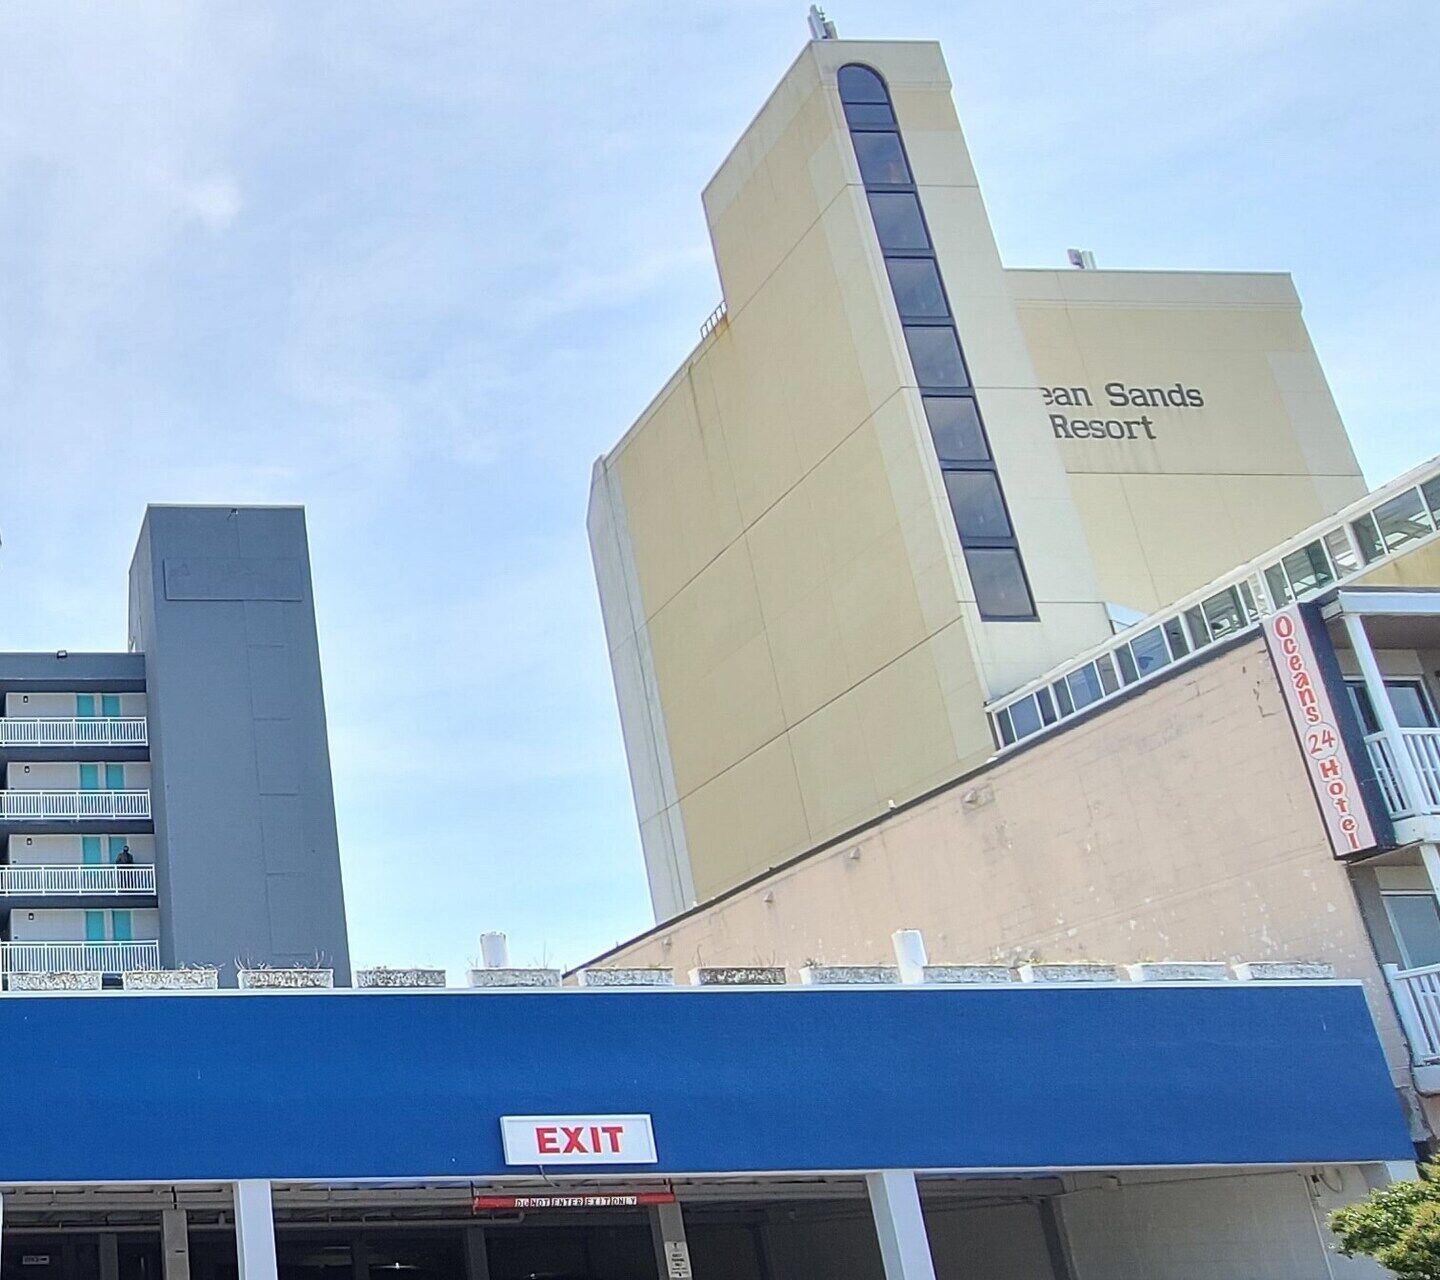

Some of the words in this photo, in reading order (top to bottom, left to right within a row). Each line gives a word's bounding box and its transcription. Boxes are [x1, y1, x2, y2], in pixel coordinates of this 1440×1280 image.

[1040, 387, 1093, 406] ean
[1104, 382, 1205, 407] Sands
[1048, 414, 1157, 440] Resort
[1274, 616, 1321, 723] Oceans
[1308, 729, 1336, 754] 24
[1319, 759, 1360, 850] Hotel
[535, 1126, 624, 1154] EXIT
[530, 1198, 550, 1207] NOT
[552, 1197, 583, 1207] ENTER
